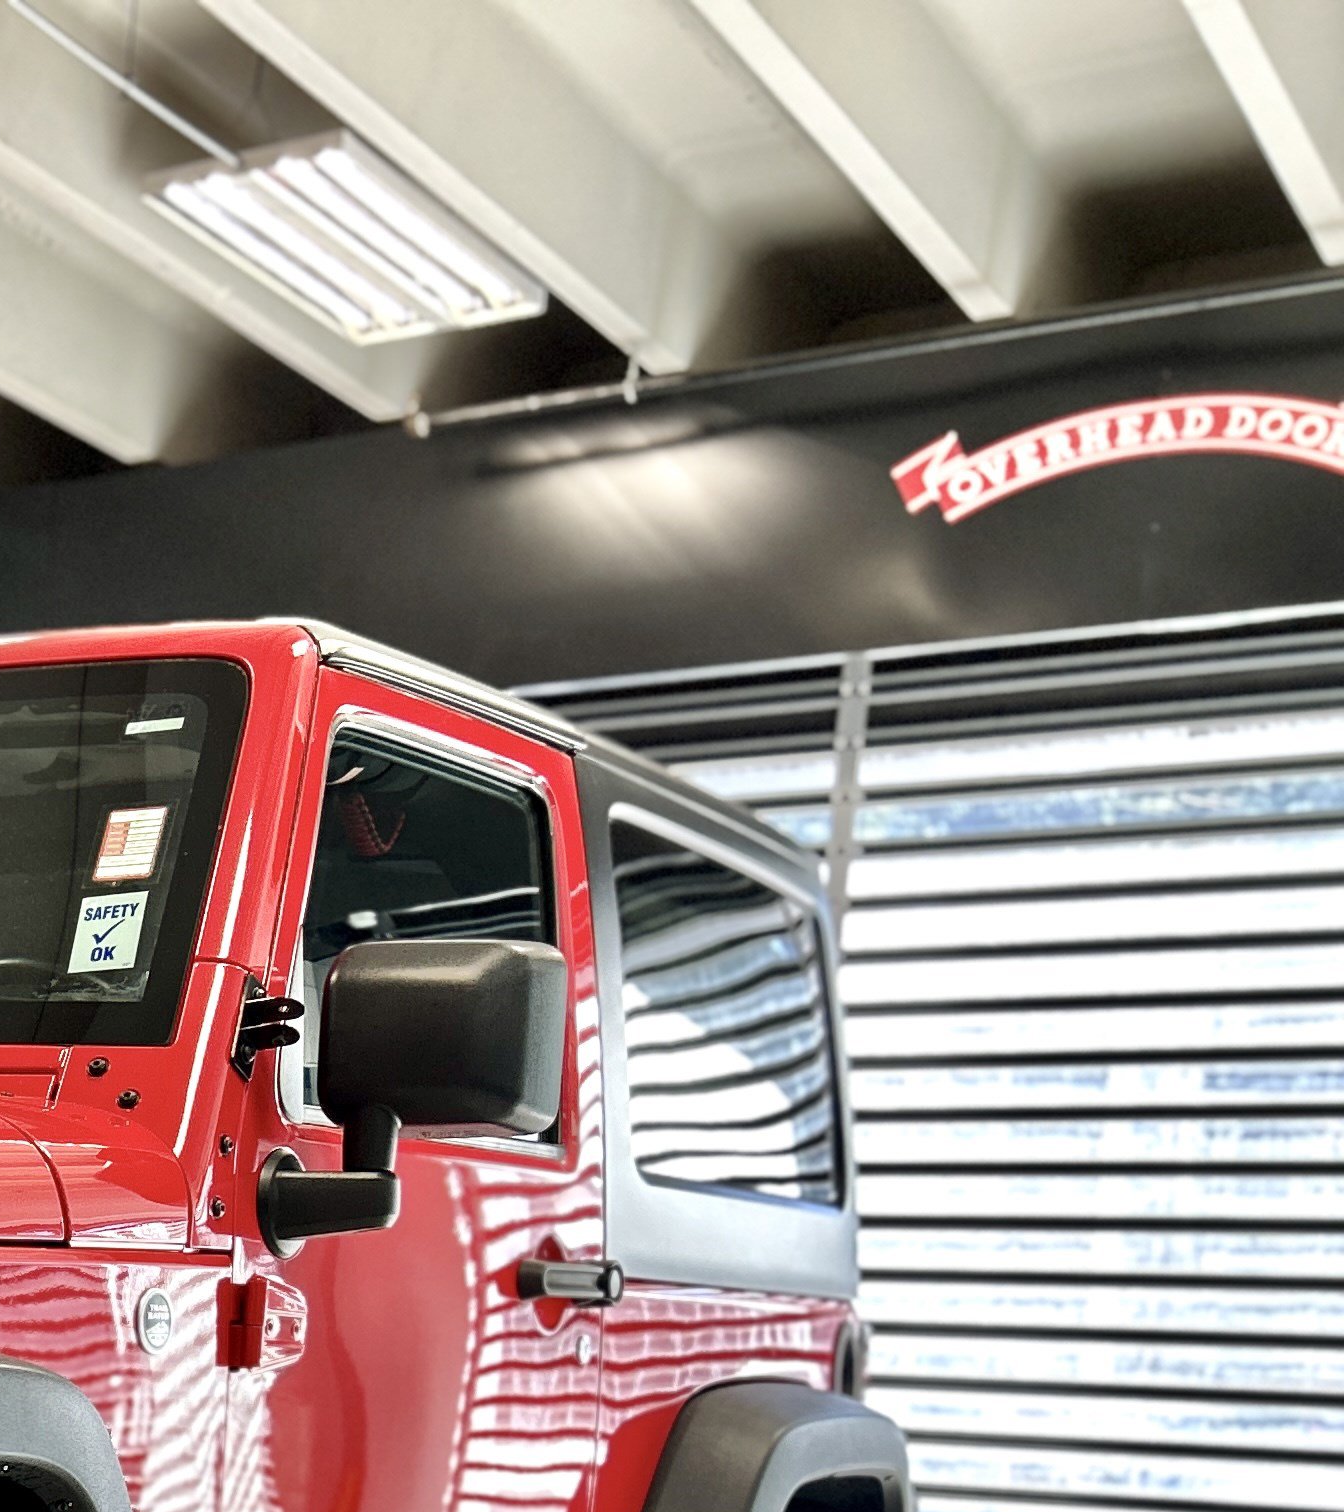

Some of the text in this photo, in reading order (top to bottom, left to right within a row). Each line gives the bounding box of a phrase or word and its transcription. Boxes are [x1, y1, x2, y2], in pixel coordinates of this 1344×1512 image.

[946, 405, 1215, 502] OVERHEAD
[84, 902, 140, 922] SAFETY
[90, 945, 117, 962] OK
